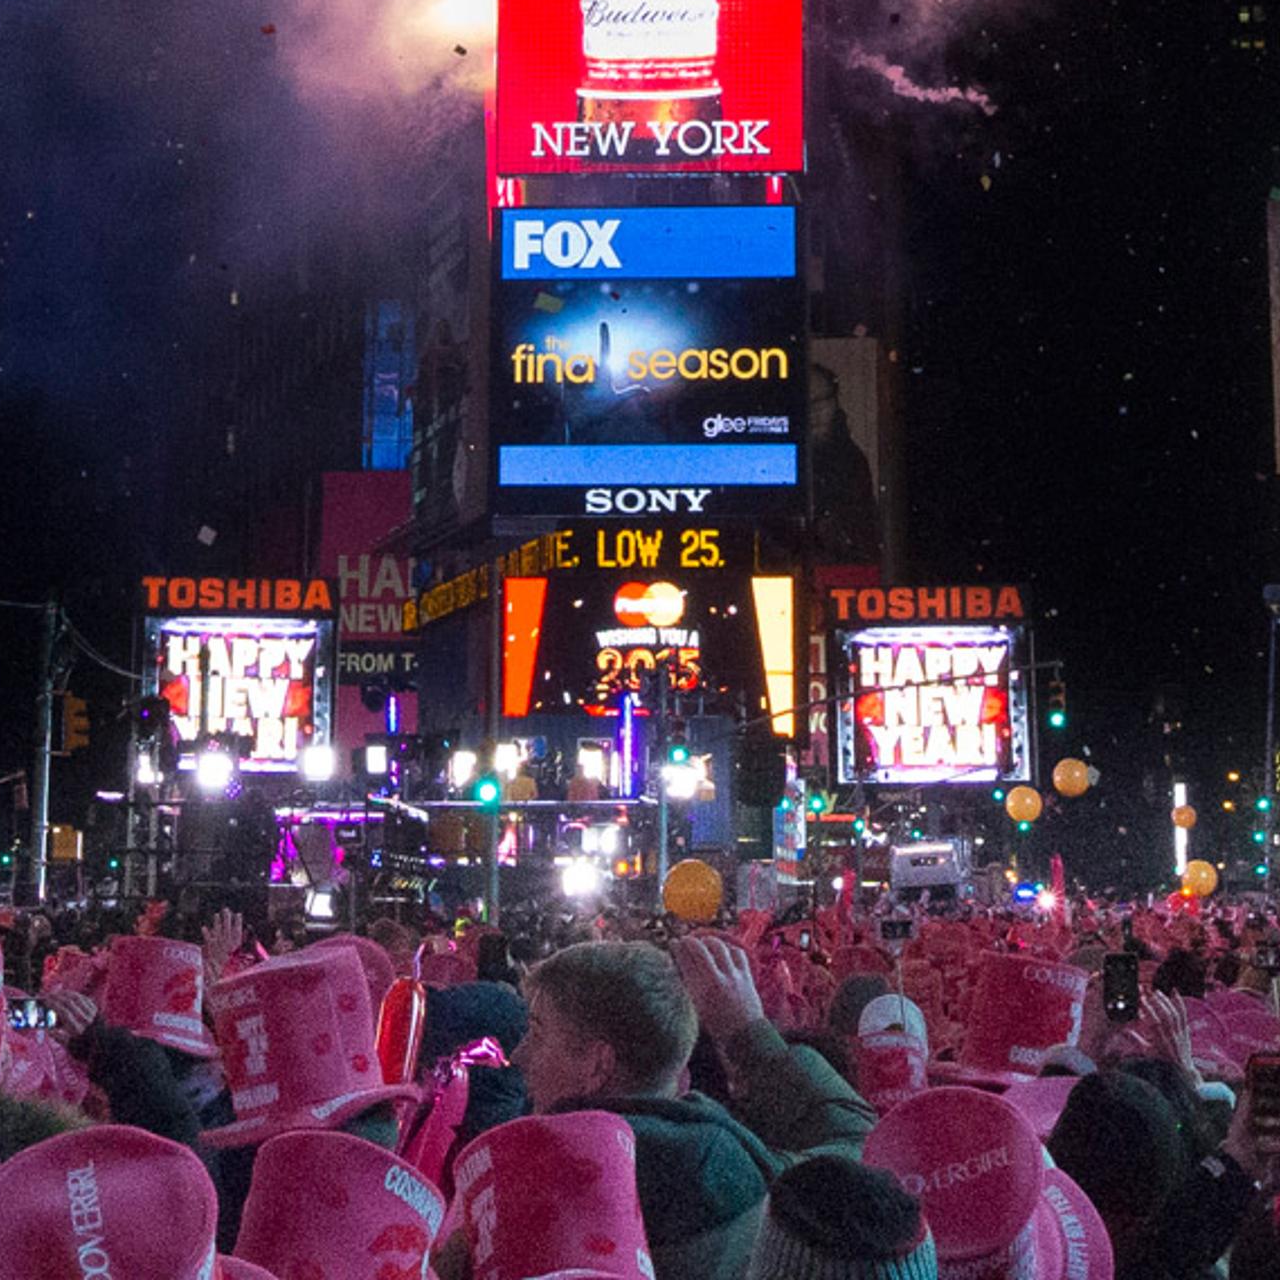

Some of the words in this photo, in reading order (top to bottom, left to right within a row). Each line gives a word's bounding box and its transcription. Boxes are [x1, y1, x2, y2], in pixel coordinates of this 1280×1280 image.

[532, 122, 631, 157] NEW
[646, 120, 770, 156] YORK
[513, 220, 622, 269] FOX
[627, 347, 788, 381] season
[702, 413, 746, 437] glee
[585, 488, 711, 513] SONY
[597, 530, 663, 567] LOW
[680, 530, 725, 567] 25.
[142, 577, 332, 611] TOSHIBA
[338, 554, 418, 599] HA
[339, 603, 403, 633] NEW
[830, 587, 1023, 620] TOSHIBA
[167, 636, 314, 679] HAPPY
[338, 652, 395, 673] FROM
[859, 643, 1007, 687] HAPPY
[884, 686, 985, 727] NEW
[867, 724, 999, 766] YEAR!
